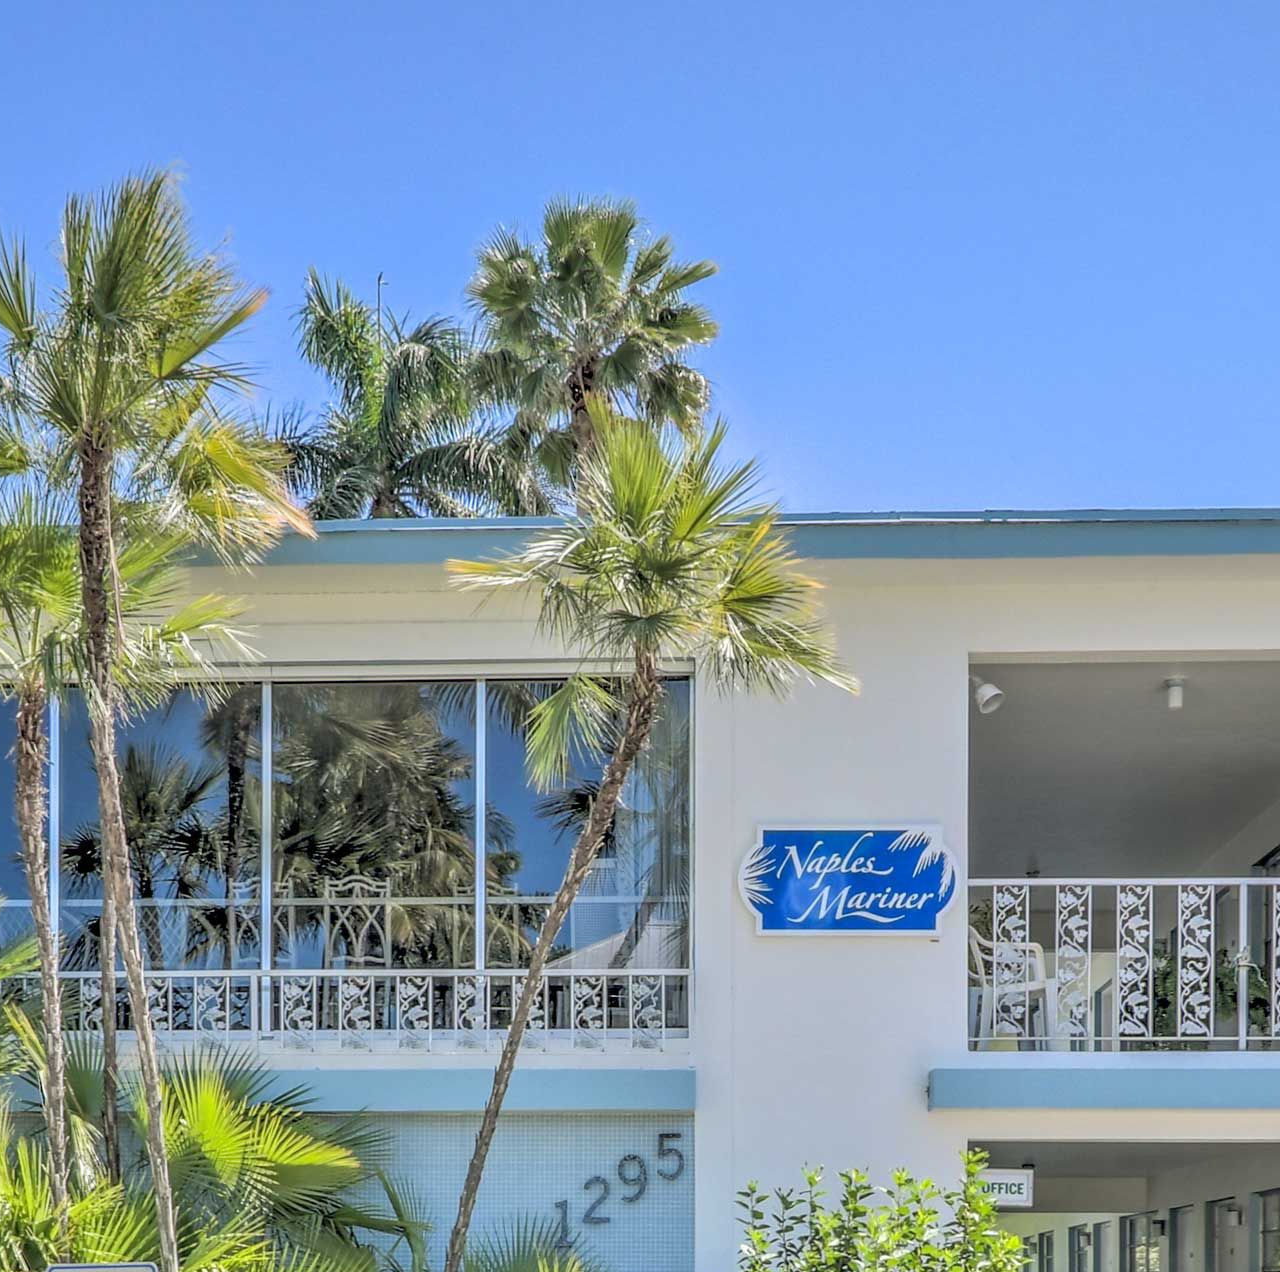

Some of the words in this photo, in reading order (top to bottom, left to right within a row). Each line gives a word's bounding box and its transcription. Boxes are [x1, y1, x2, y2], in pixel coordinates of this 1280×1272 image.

[777, 832, 894, 890] Naples
[786, 885, 934, 923] Mariner
[554, 1133, 685, 1248] 1295
[982, 1183, 1024, 1195] OFFICE
